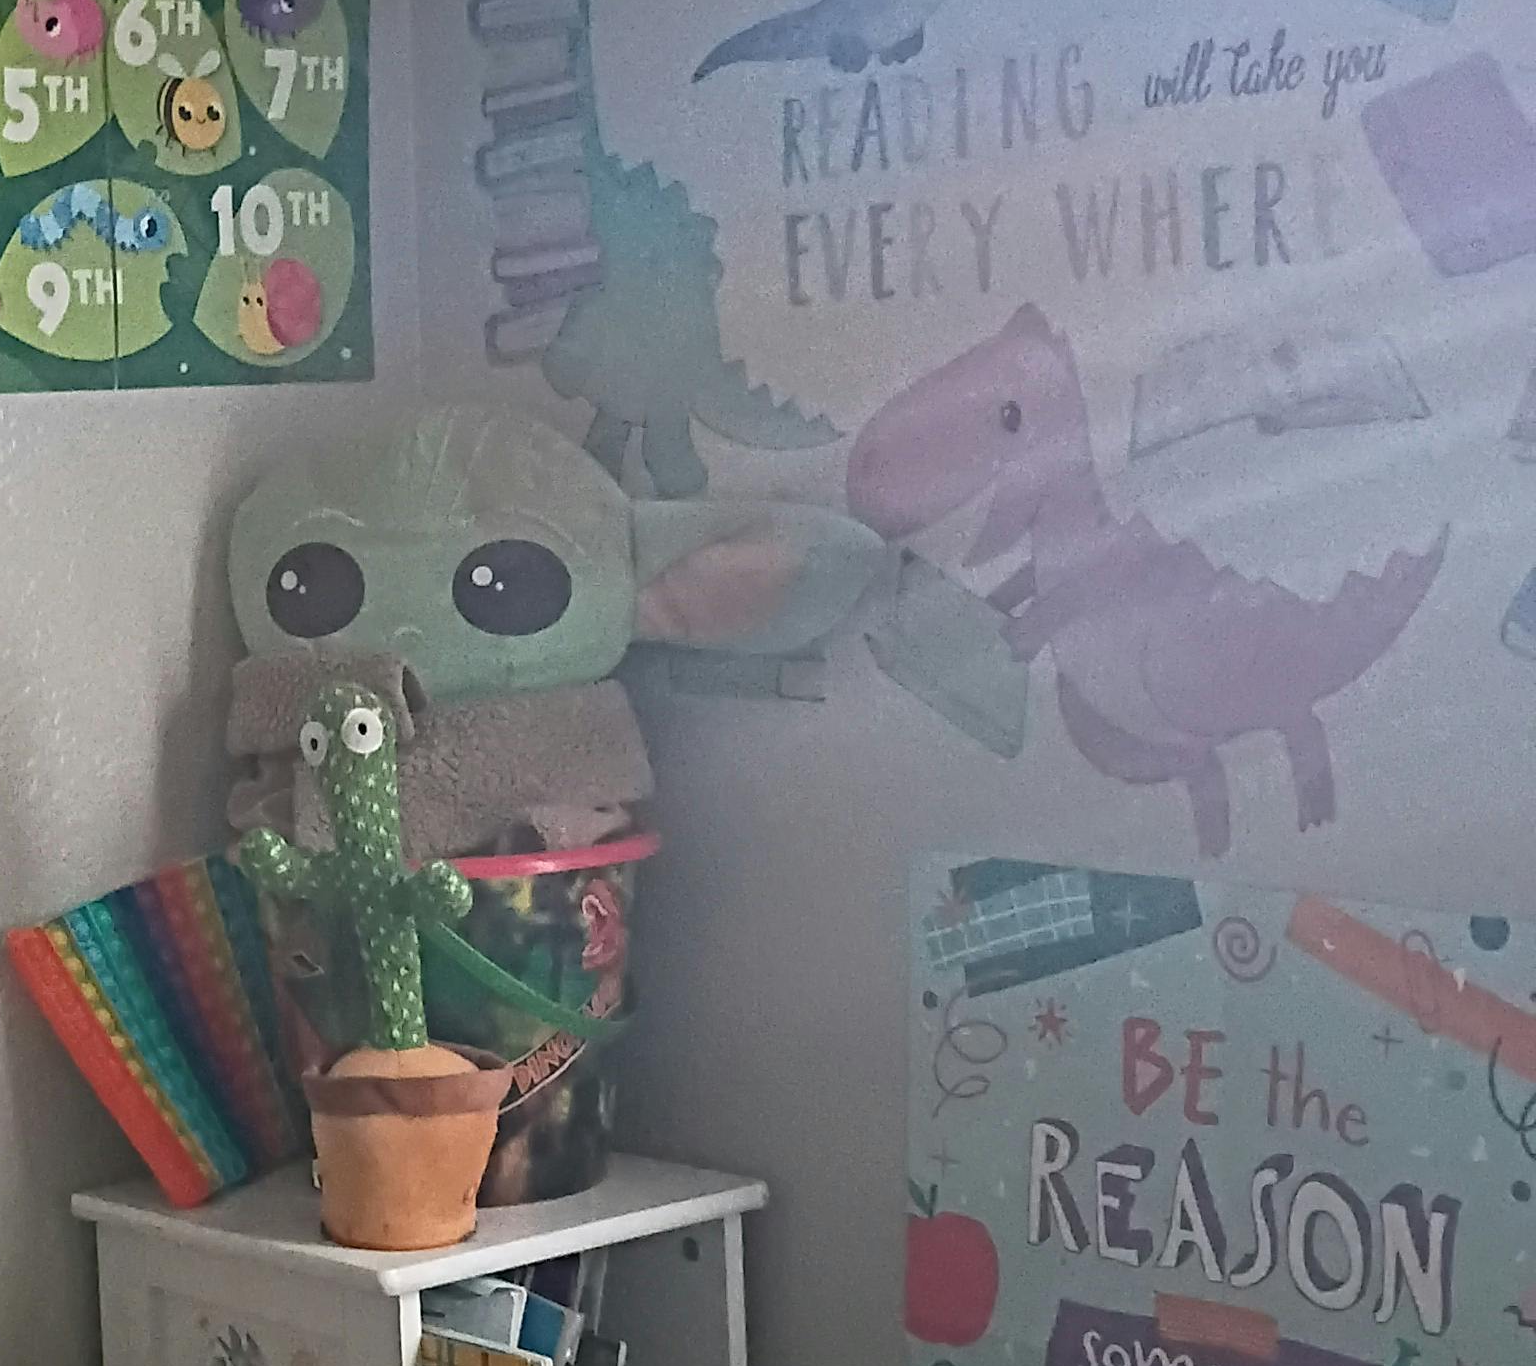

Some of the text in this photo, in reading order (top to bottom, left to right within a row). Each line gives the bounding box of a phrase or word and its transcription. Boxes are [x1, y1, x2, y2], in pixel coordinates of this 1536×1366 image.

[1, 66, 90, 143] 5TH
[263, 48, 345, 121] 7TH
[781, 43, 1095, 189] READING
[1144, 37, 1216, 110] will
[1321, 41, 1388, 121] you
[210, 183, 331, 257] 10TH
[784, 148, 1348, 307] EVERY WHERE
[25, 260, 124, 337] 9TH
[1122, 1015, 1370, 1147] BE the
[1027, 1116, 1463, 1336] REASON
